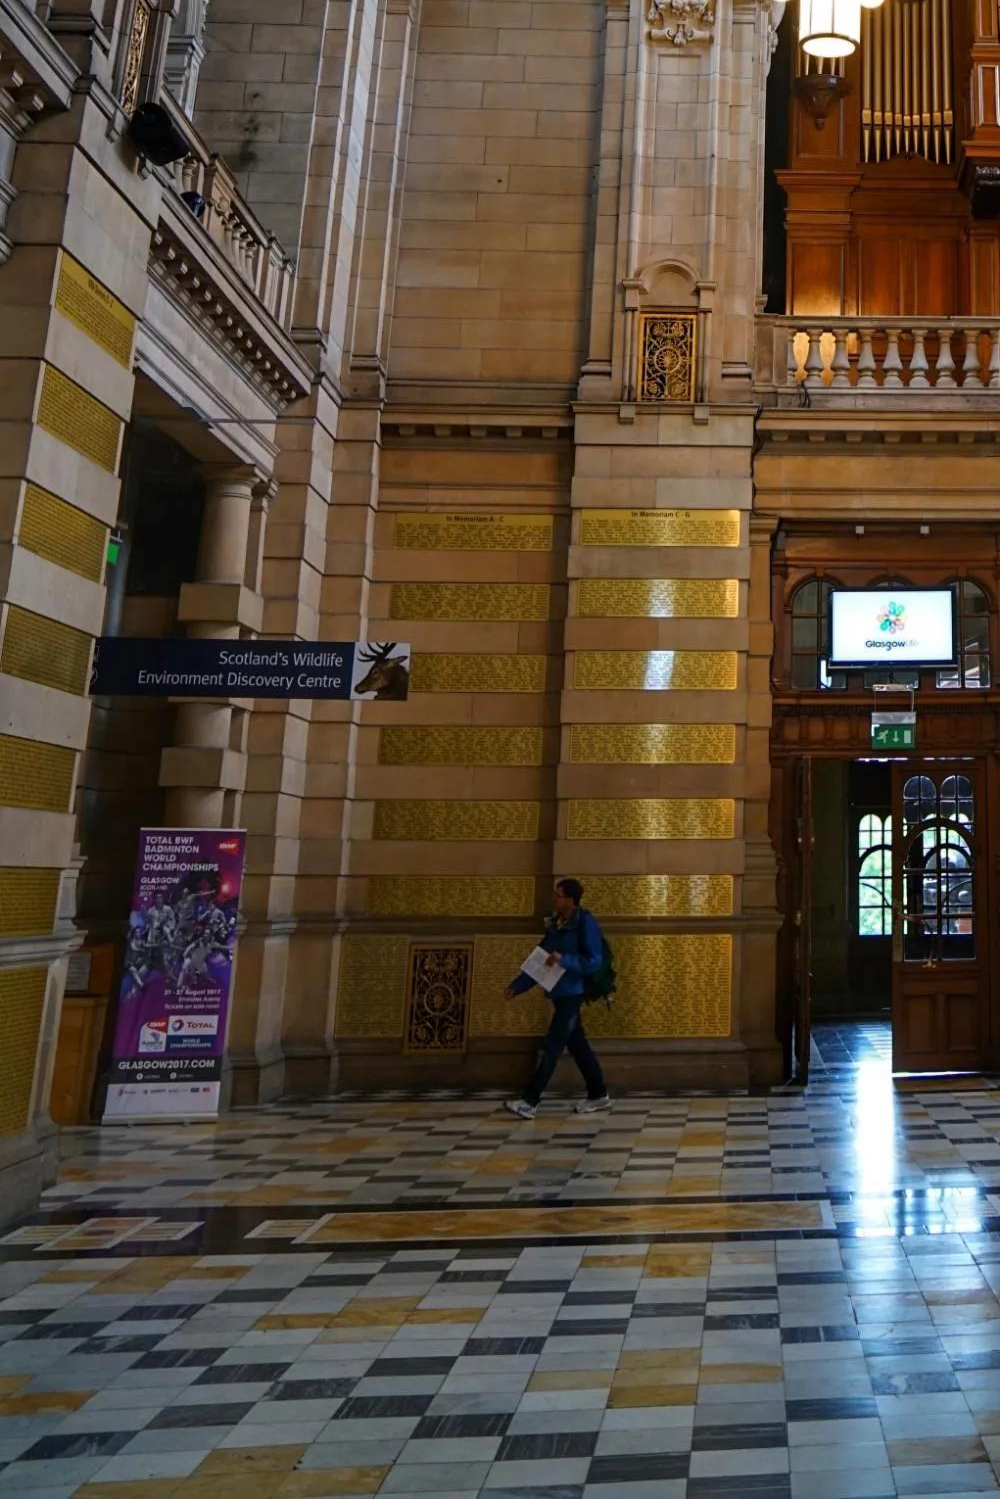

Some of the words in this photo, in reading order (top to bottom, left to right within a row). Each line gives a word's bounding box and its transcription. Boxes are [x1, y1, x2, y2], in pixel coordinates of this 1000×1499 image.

[640, 510, 674, 518] Memoriam
[218, 651, 288, 666] Scotland's
[293, 652, 343, 667] Wildlife
[138, 670, 223, 686] Environment
[227, 672, 293, 689] Discovery
[297, 673, 341, 688] Centre
[145, 836, 173, 845] TOTAL
[175, 836, 195, 845] BWF
[145, 845, 200, 853] BADMINTON
[144, 854, 177, 862] WORLD
[142, 863, 219, 872] CHAMPIONSHIPS
[118, 1059, 215, 1070] GLASGOW2017.COM
